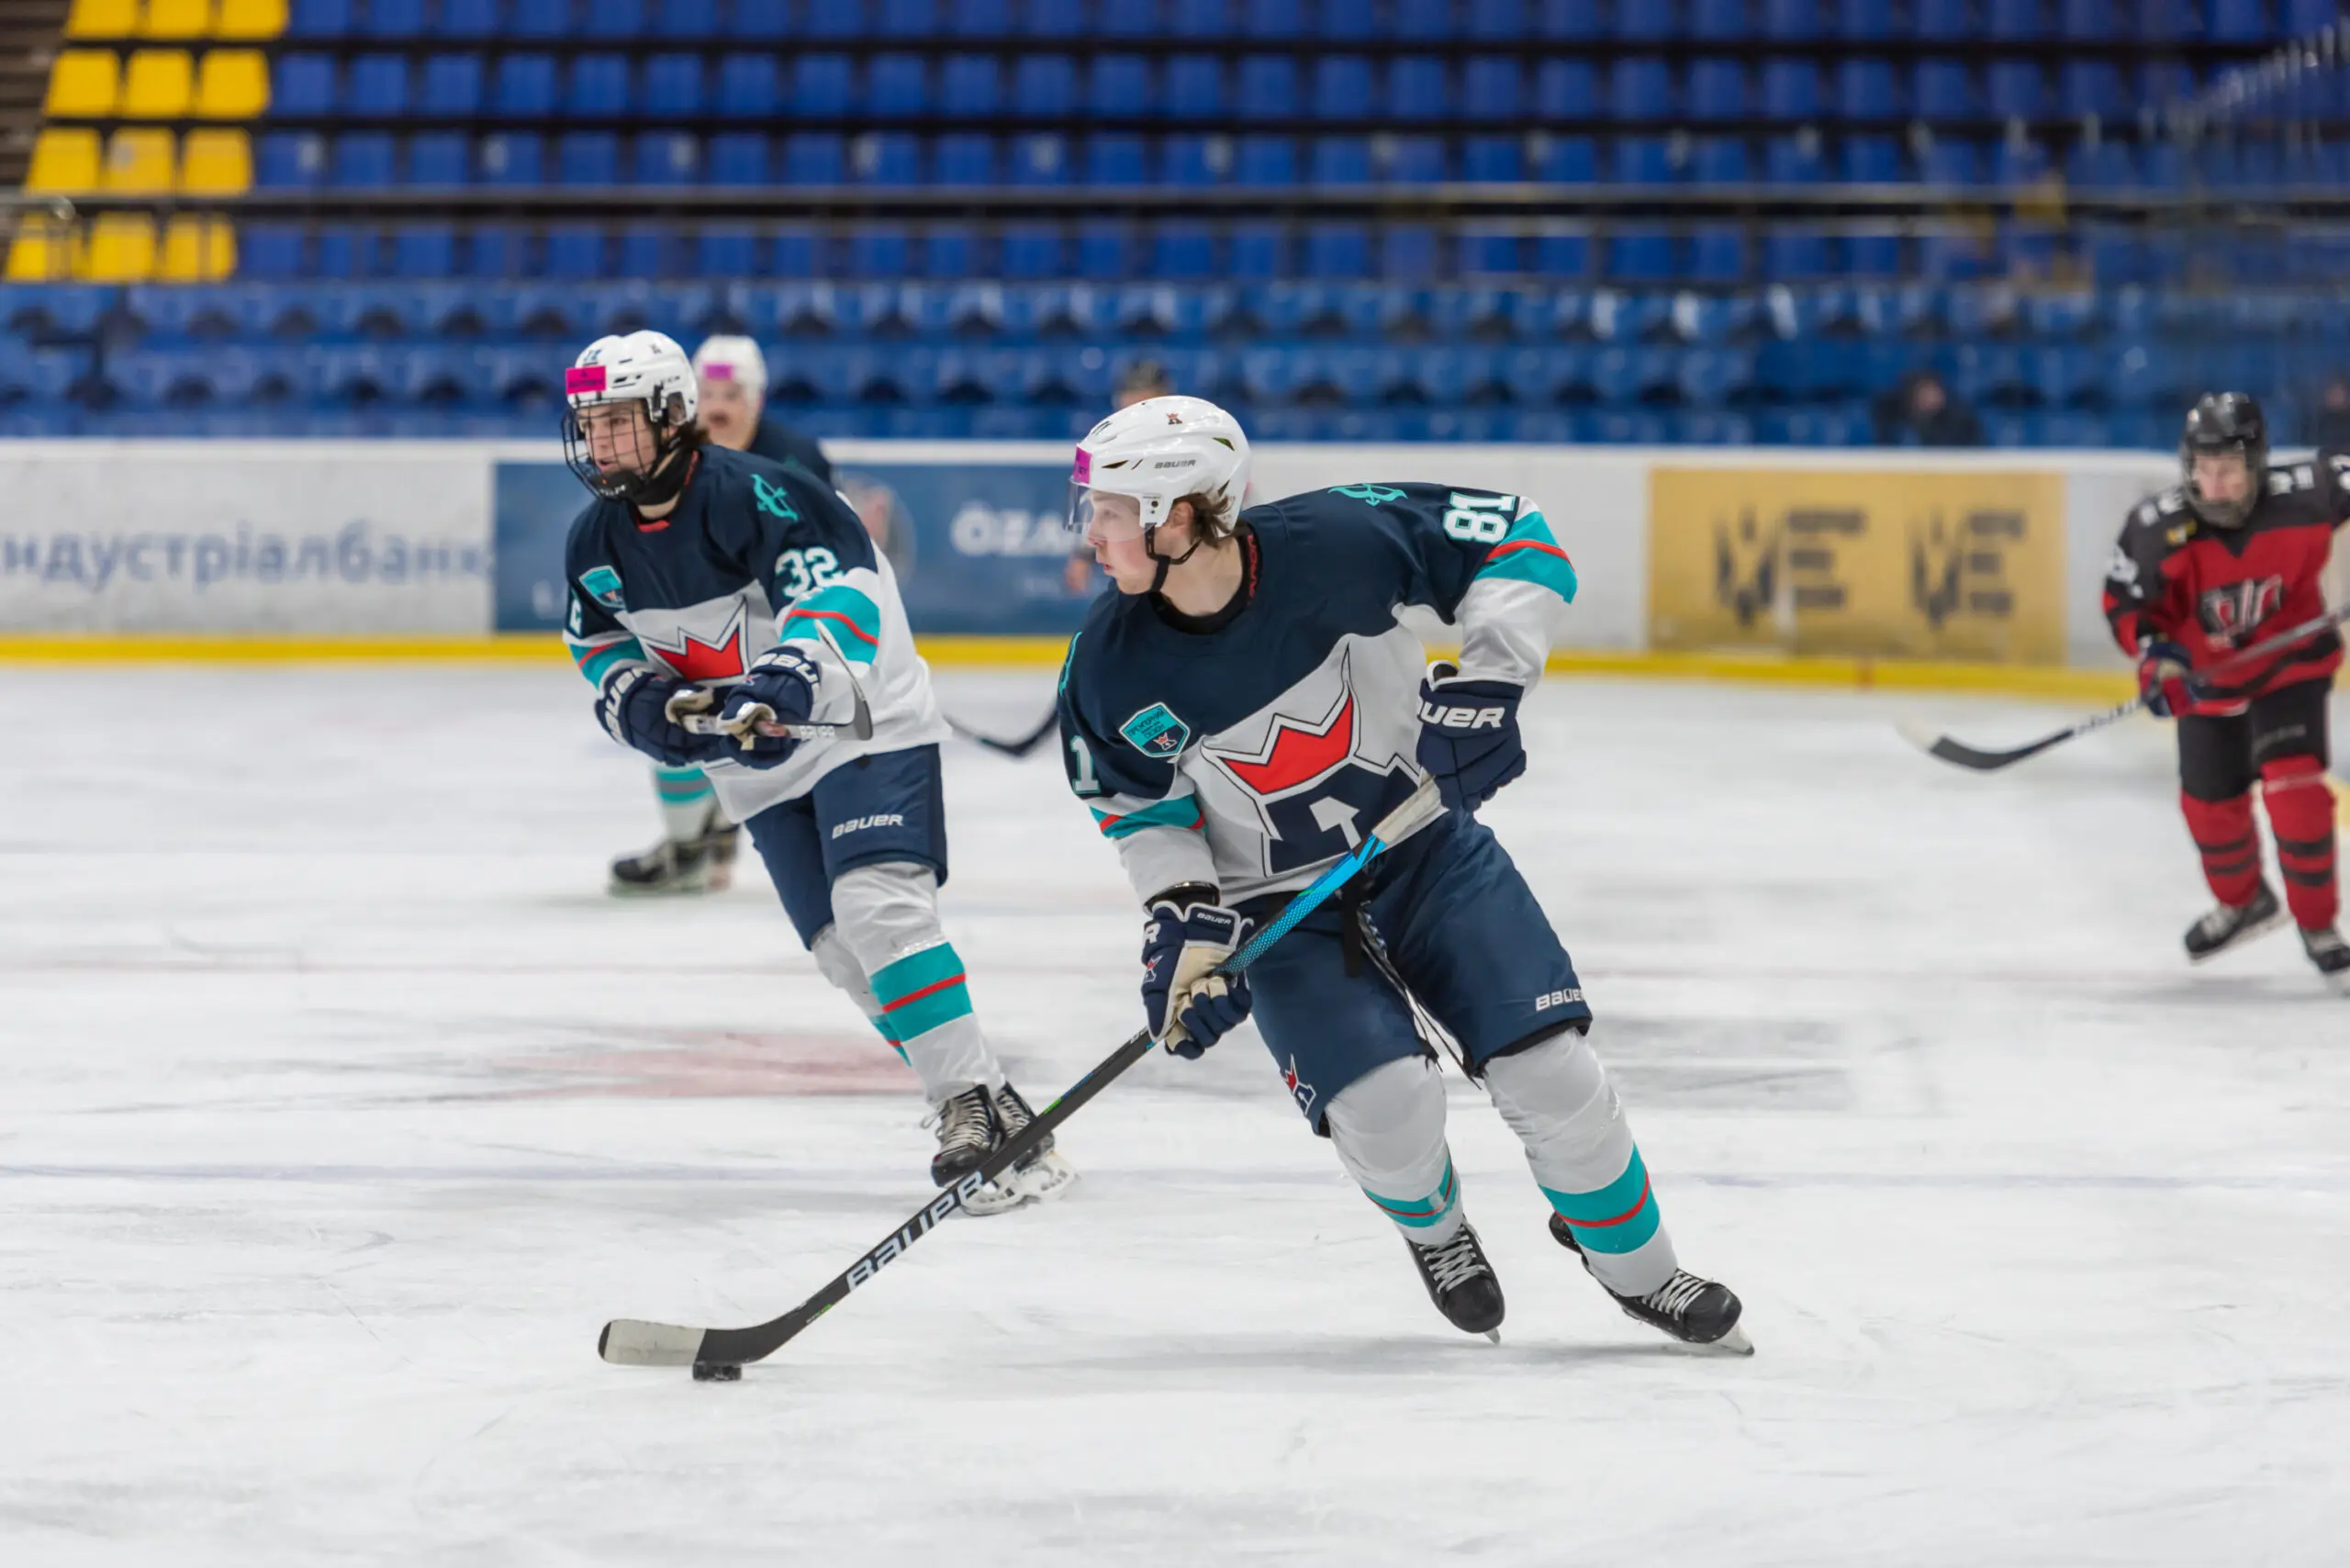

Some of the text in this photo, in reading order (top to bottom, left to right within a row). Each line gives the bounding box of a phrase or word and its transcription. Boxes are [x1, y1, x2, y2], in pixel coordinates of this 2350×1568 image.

[1443, 491, 1516, 544] 81
[775, 545, 843, 599] 32
[832, 813, 903, 839] BAUER
[1196, 912, 1232, 925] BAUER
